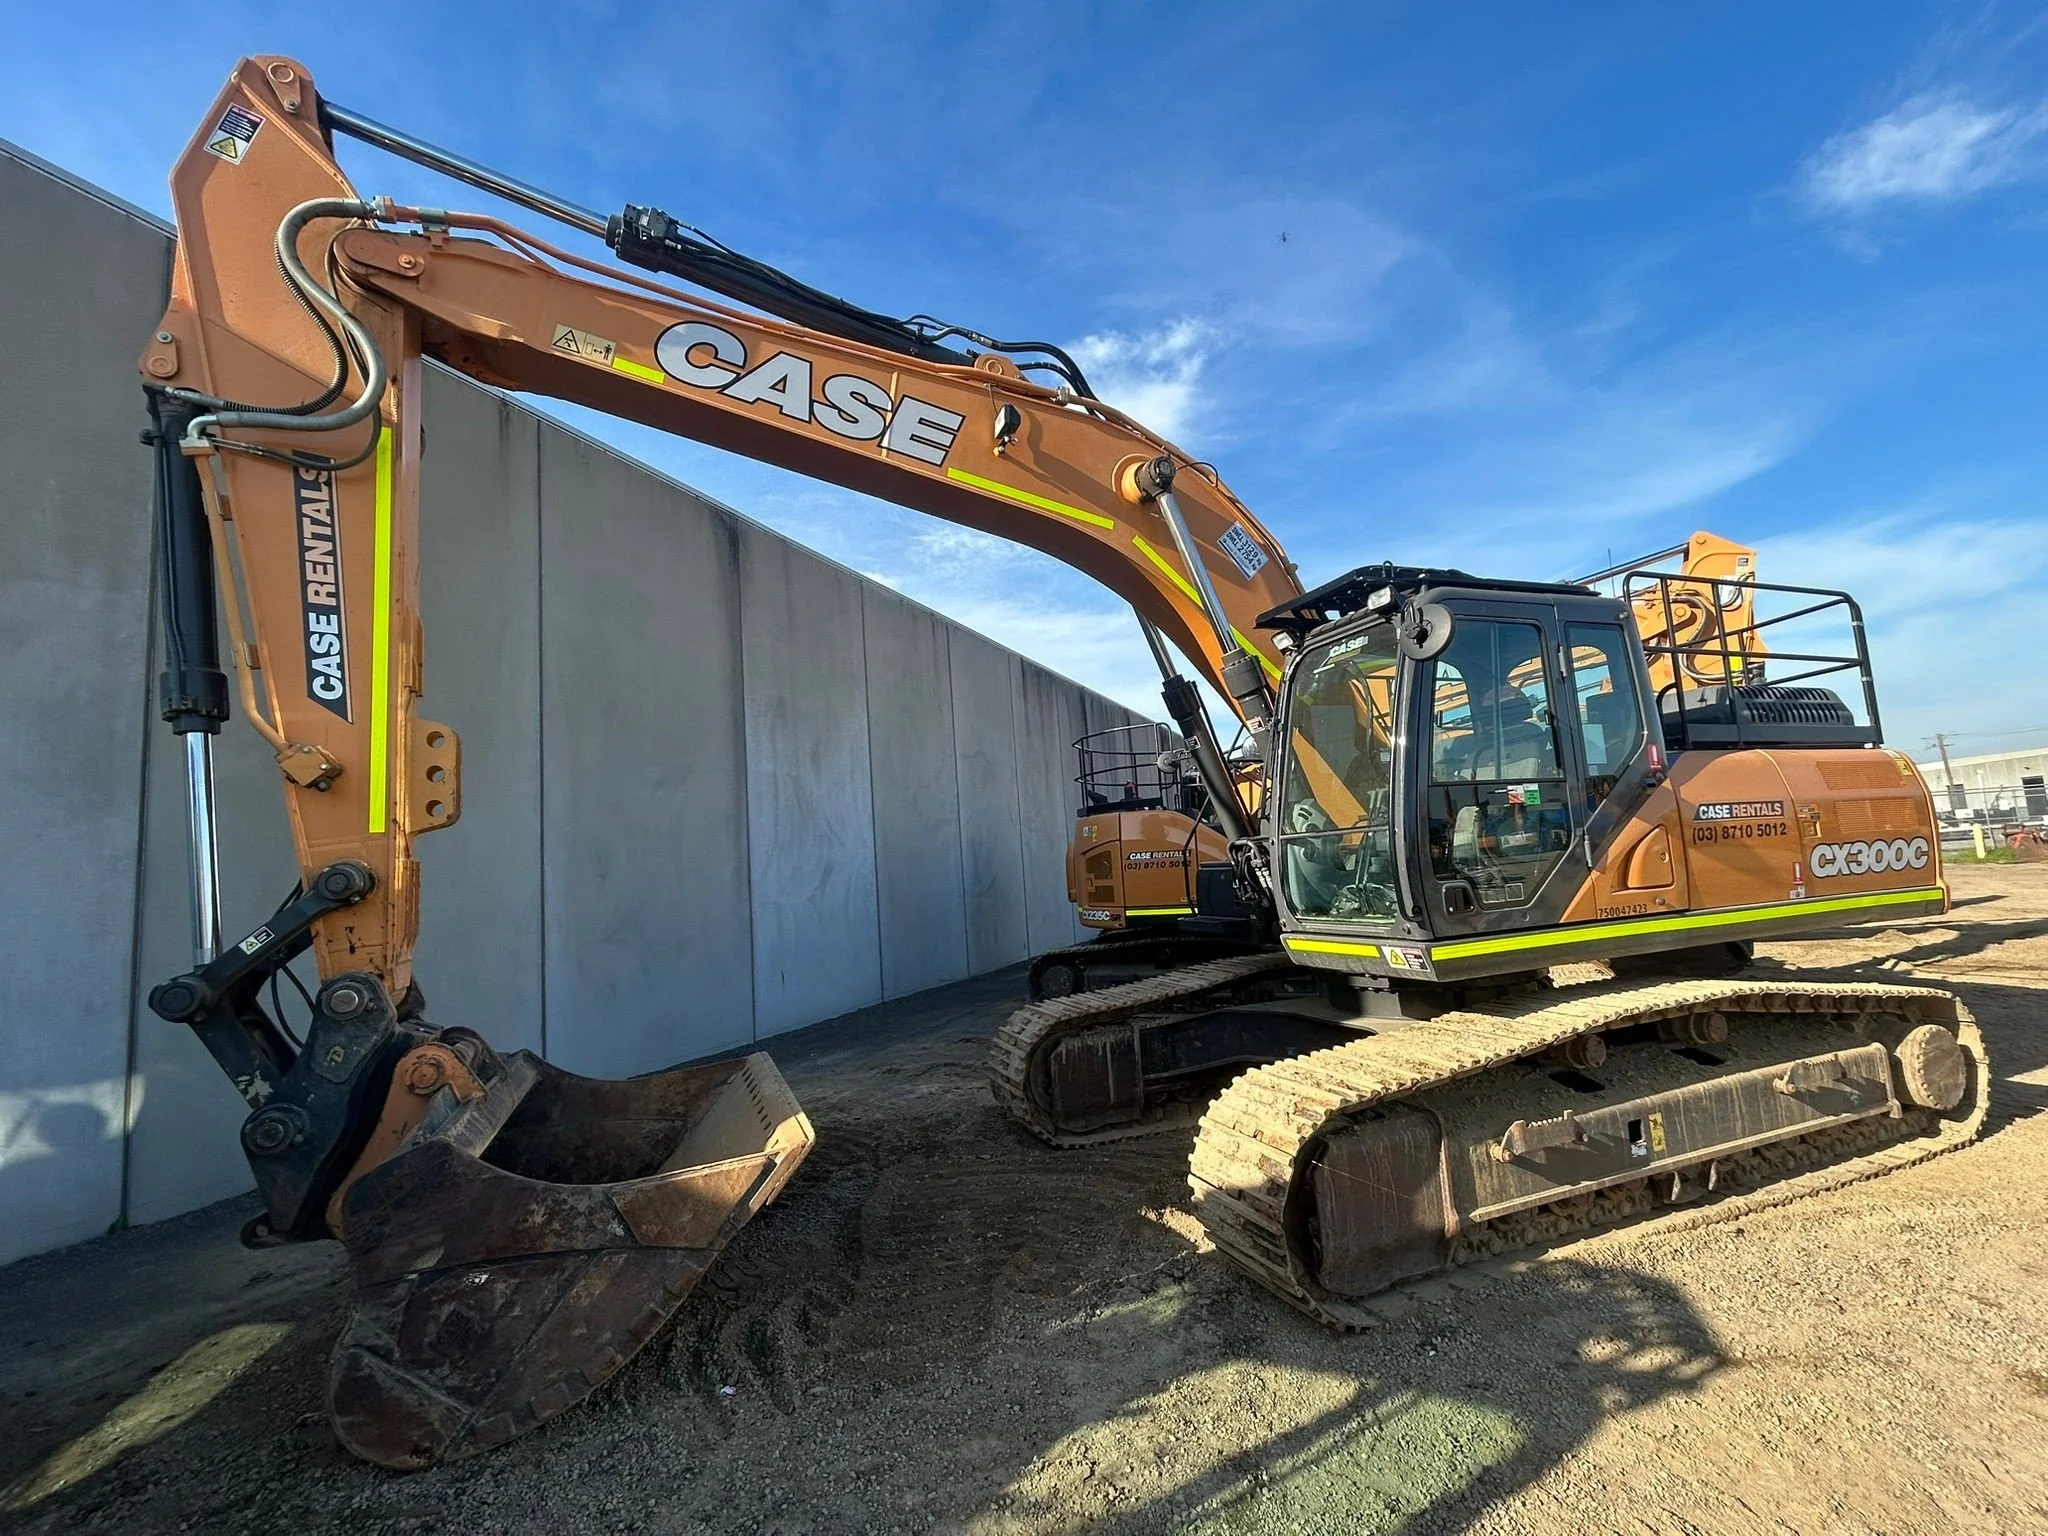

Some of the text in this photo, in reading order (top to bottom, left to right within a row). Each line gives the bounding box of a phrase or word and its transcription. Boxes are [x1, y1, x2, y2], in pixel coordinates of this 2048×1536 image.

[654, 320, 965, 467] CASE
[1237, 545, 1253, 564] 2754
[1242, 539, 1259, 558] 3129
[299, 466, 343, 700] CASE RENTALS
[1699, 803, 1783, 819] CASE RENTALS
[1692, 822, 1787, 845] (03) 8710 5012
[1130, 852, 1152, 860] CASE
[1811, 836, 1929, 879] CX300C
[1124, 862, 1141, 872] (03)
[1143, 861, 1166, 869] 8710
[1598, 903, 1648, 917] 750047423
